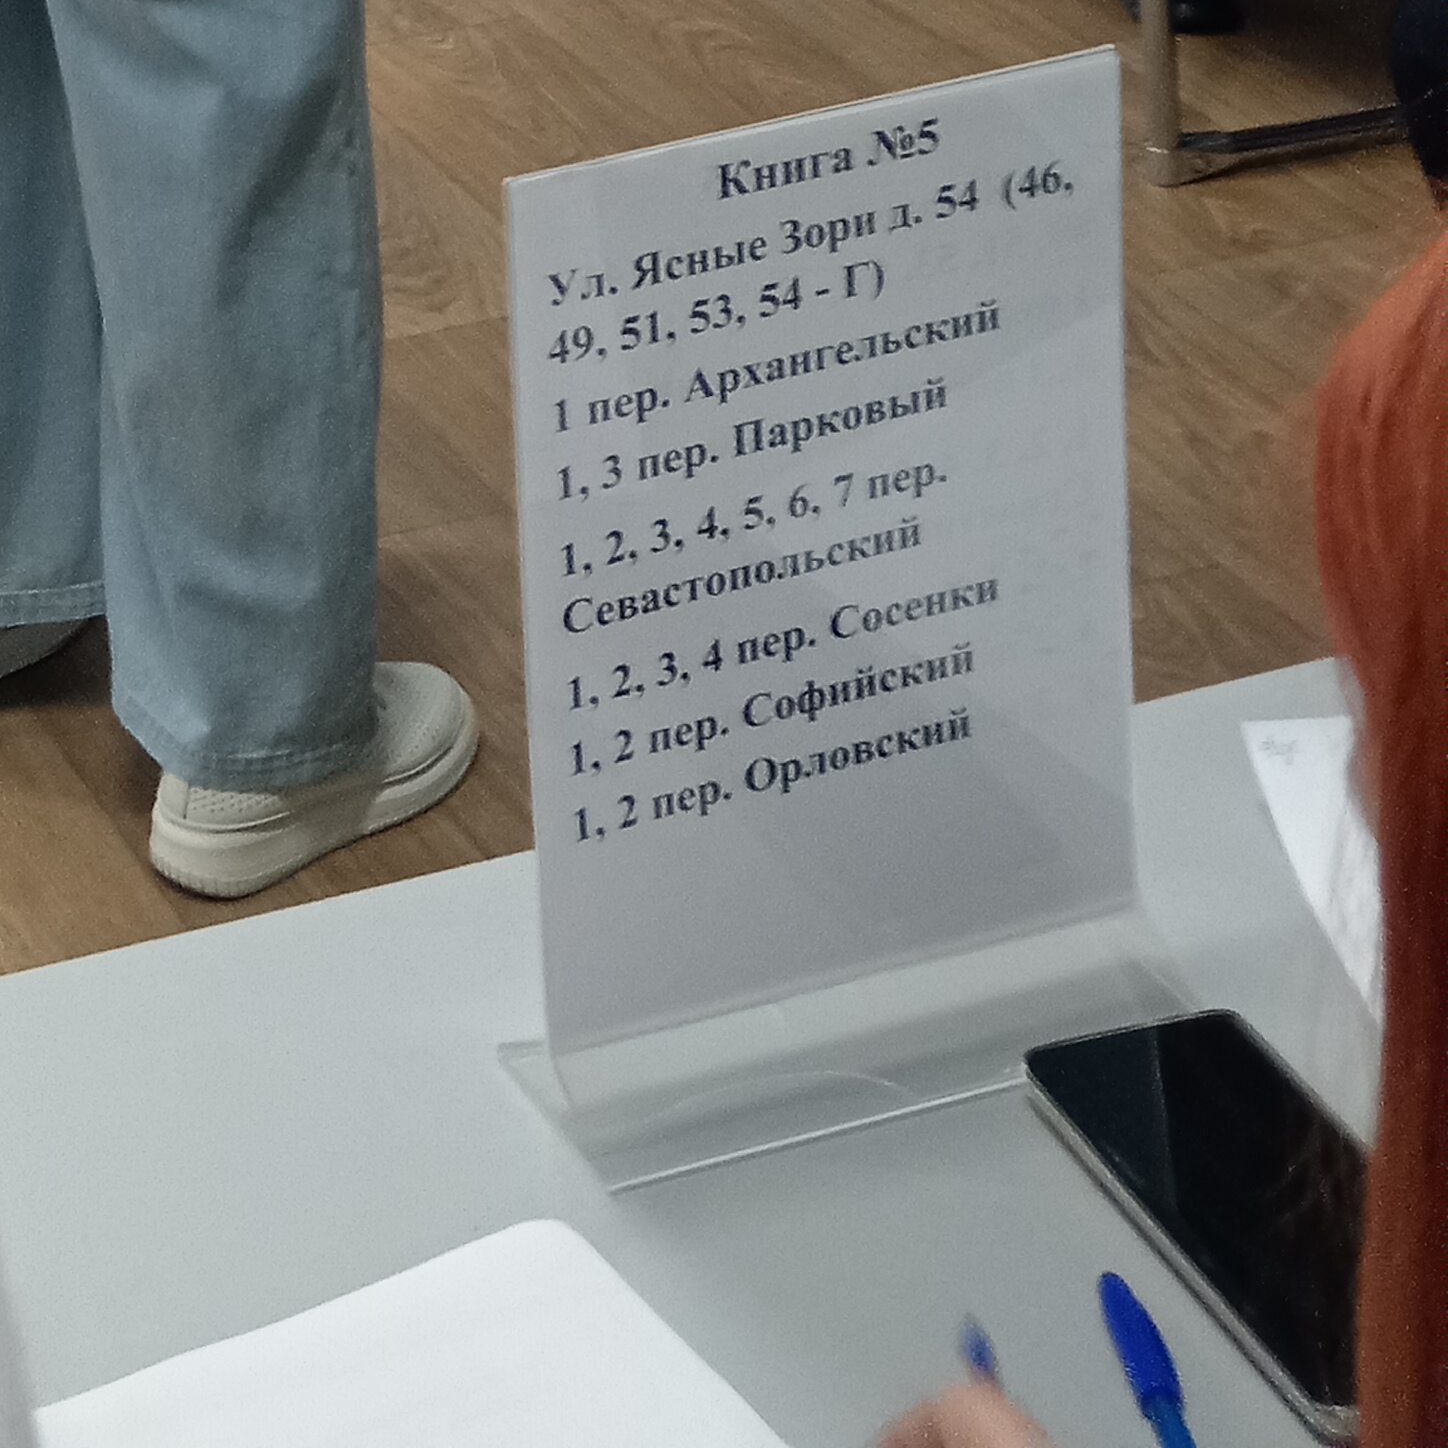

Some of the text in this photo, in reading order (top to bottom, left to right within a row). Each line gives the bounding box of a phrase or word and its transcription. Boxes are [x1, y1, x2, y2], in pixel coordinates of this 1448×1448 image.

[716, 116, 941, 201] Книга №5
[546, 160, 1075, 308] Ул. Ясные Зори д. 54 (46,
[546, 325, 609, 366] 49,
[619, 310, 678, 352] 51,
[688, 293, 748, 335] 53,
[758, 275, 804, 319] 54
[842, 258, 888, 300] Г)
[553, 298, 1001, 433] 1 пер. Архангельский
[556, 375, 949, 504] 1, 3 пер. Парковый
[560, 542, 595, 579] 1,
[604, 529, 640, 567] 2,
[649, 517, 687, 555] 3,
[695, 505, 732, 544] 4,
[833, 472, 855, 508] 7
[867, 462, 949, 507] пер.
[562, 514, 922, 635] Севастопольский
[567, 577, 1000, 712] 1, 2, 3, 4 пер. Сосенки
[570, 639, 975, 777] 1, 2 пер. Софийский
[573, 705, 973, 842] 1, 2 пер. Орловский
